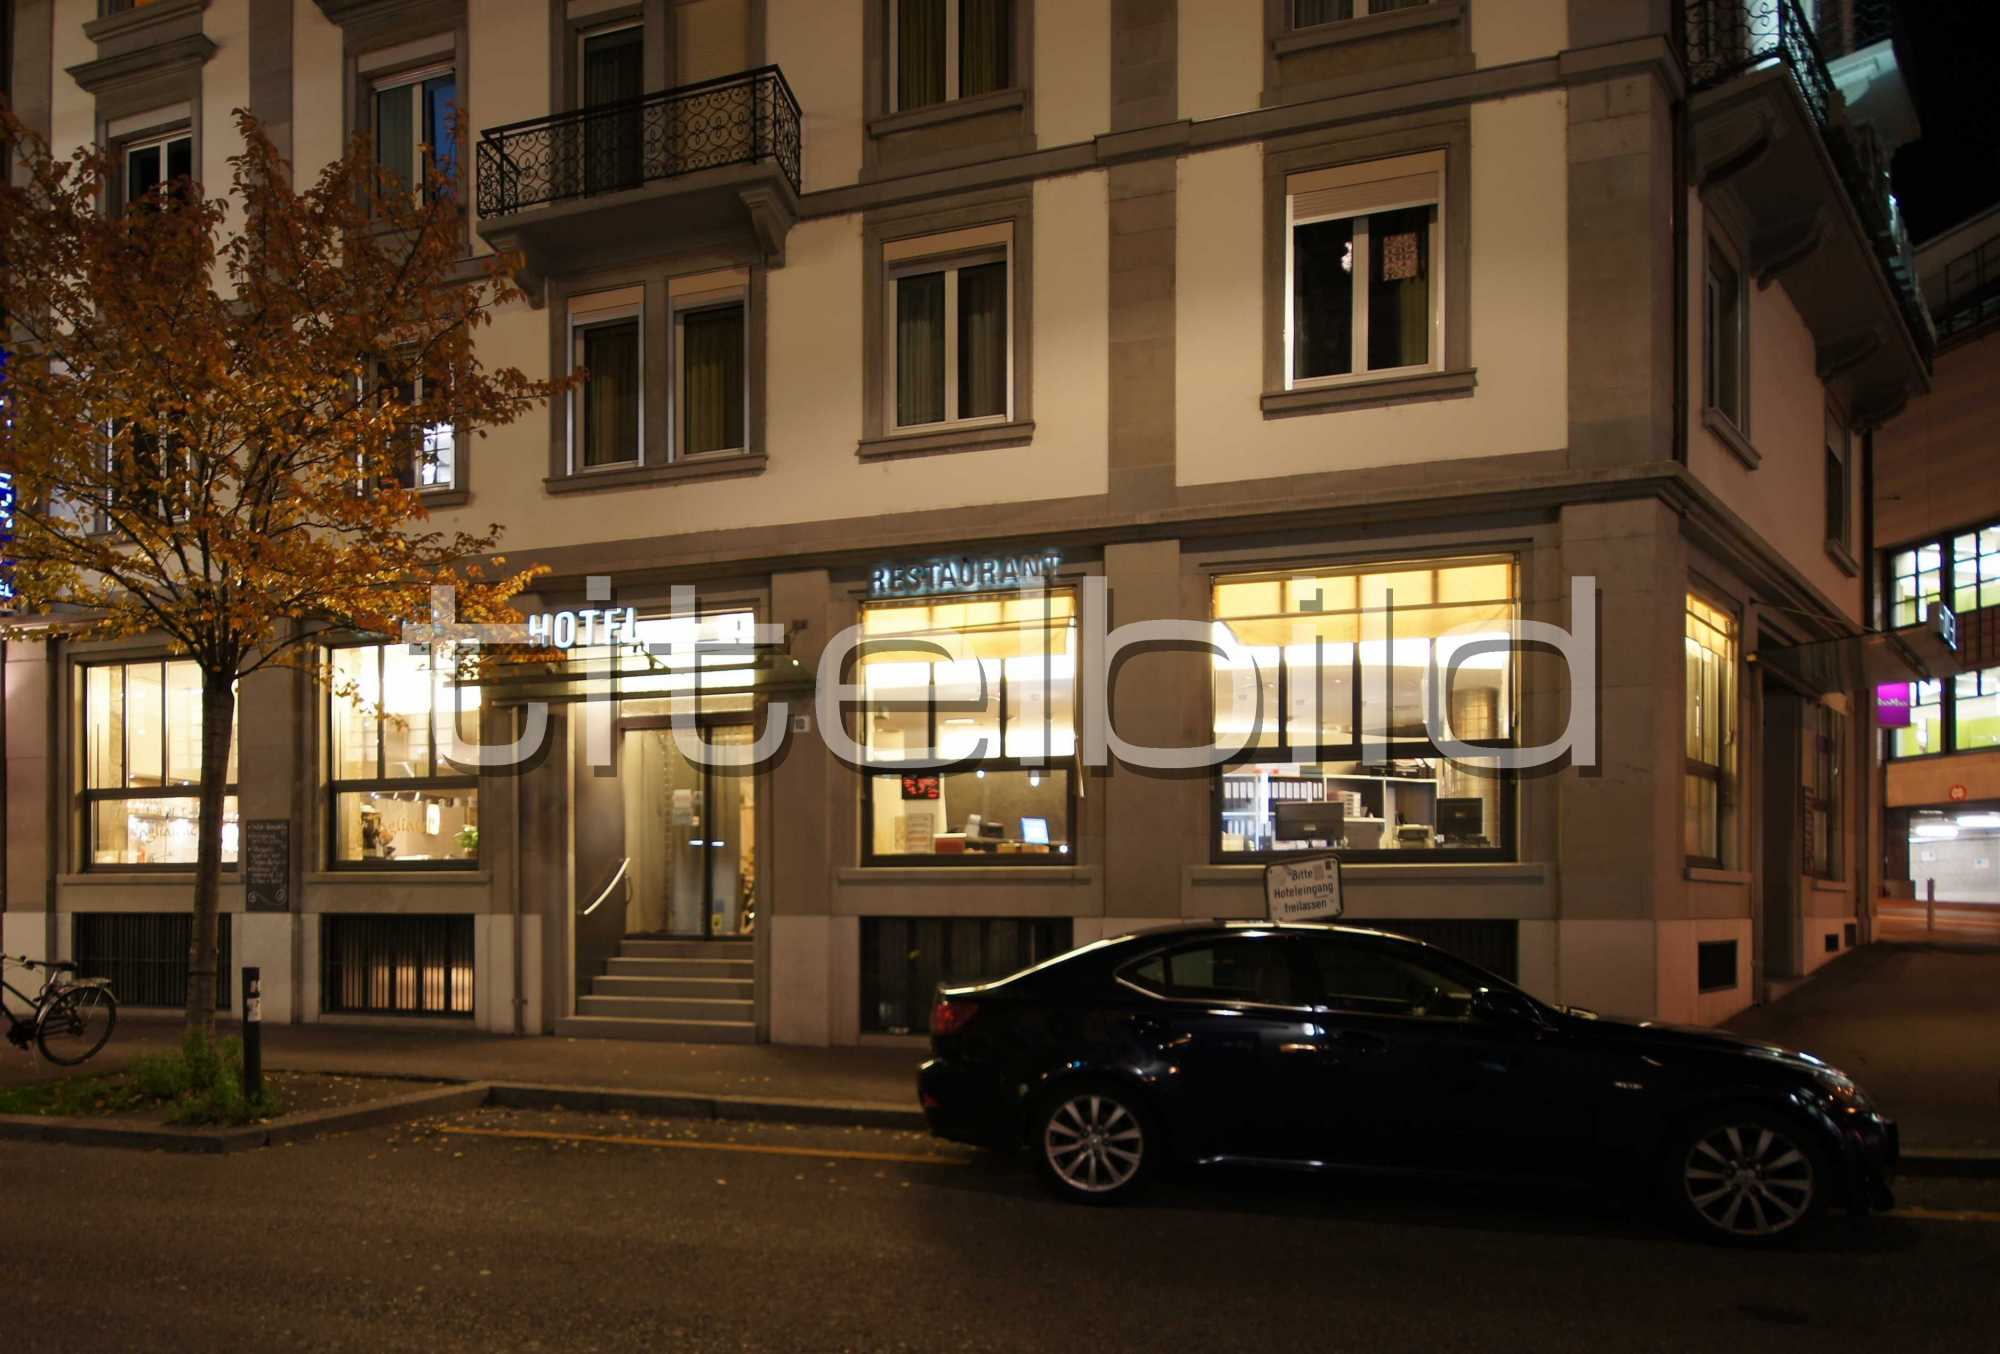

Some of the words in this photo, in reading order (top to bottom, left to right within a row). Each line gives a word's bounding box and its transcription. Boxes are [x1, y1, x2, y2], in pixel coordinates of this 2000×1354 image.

[871, 550, 1064, 596] RESTAURANT
[528, 607, 641, 649] HOTEL
[1291, 869, 1313, 881] Bitte
[1273, 882, 1334, 899] Hoteleingang
[1284, 899, 1327, 913] freilassen
